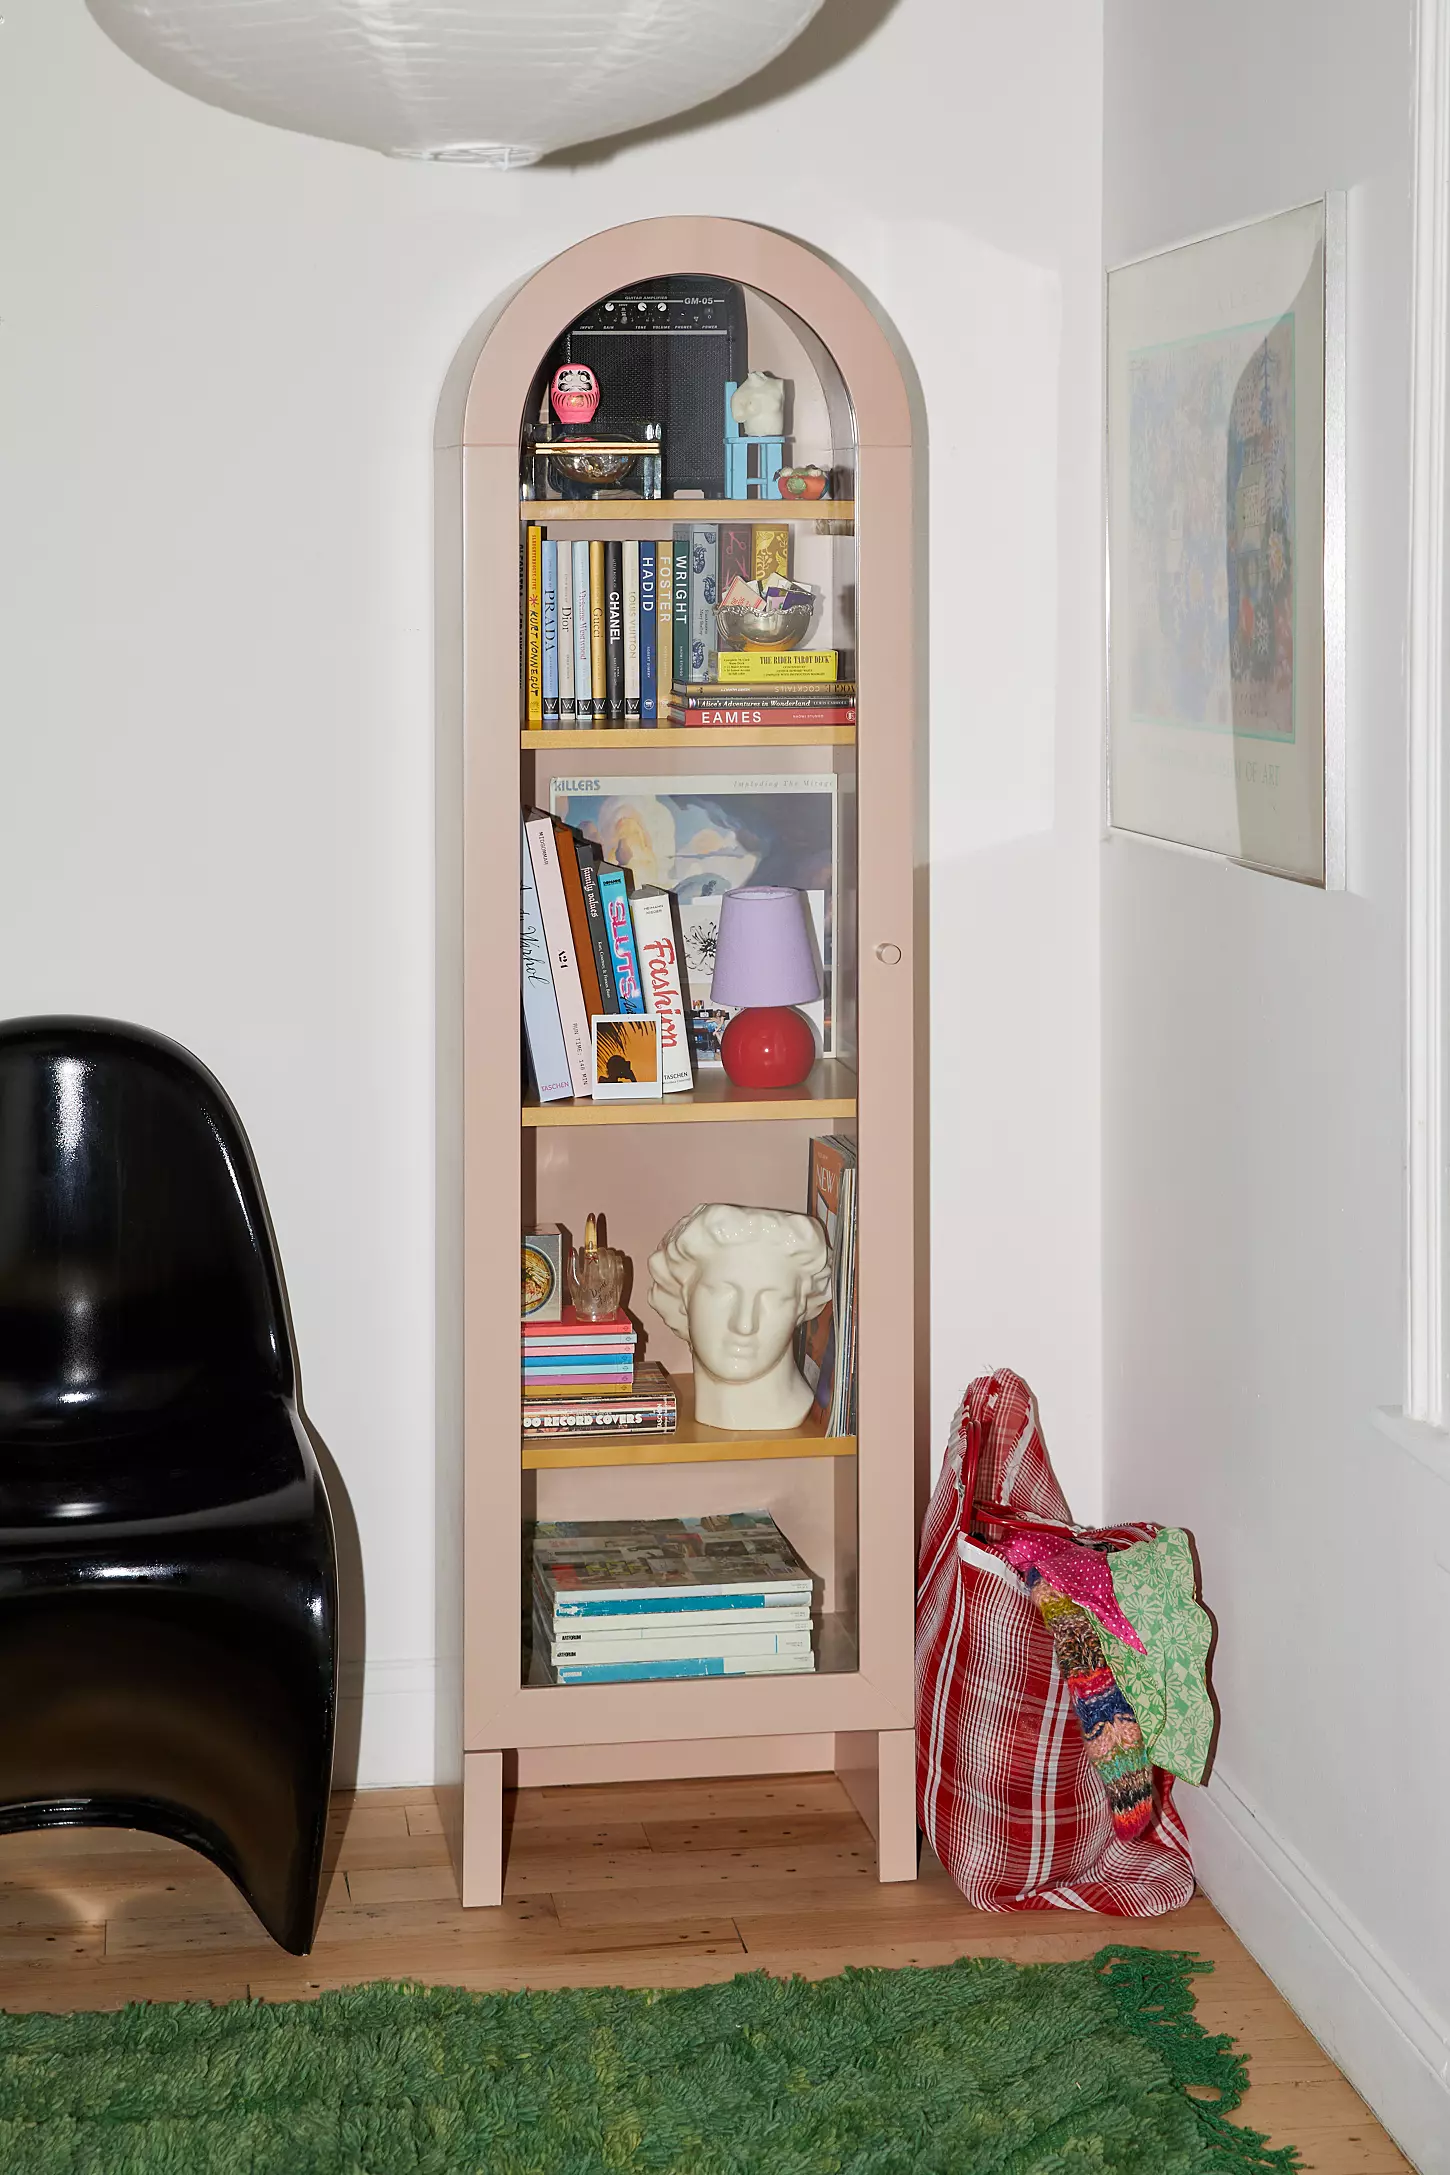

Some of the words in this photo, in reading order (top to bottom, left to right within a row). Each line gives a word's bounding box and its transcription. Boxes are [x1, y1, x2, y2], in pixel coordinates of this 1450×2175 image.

[684, 297, 713, 305] GM-05
[642, 557, 653, 611] HADID
[660, 556, 671, 622] FOSTER
[675, 556, 687, 624] WRIGHT
[579, 590, 587, 621] Vivienne
[609, 591, 620, 645] CHANEL
[628, 591, 636, 617] LOUIS
[529, 609, 539, 638] KURT
[544, 590, 556, 651] PRADA
[562, 607, 572, 632] Dior
[593, 607, 603, 638] Gucci
[628, 619, 636, 659] VUITTON
[529, 640, 539, 697] VONNEGUT
[760, 656, 772, 665] THE
[773, 656, 792, 664] RIDER
[794, 656, 814, 664] TAROT
[701, 699, 723, 707] Alice's
[724, 699, 760, 707] Adventures
[770, 699, 811, 707] Wonderland
[701, 711, 762, 724] EAMES
[554, 779, 601, 791] KILLERS
[732, 780, 779, 789] Imploding
[580, 866, 594, 892] family
[587, 892, 599, 918] values
[520, 926, 550, 988] Warhol
[608, 900, 637, 999] SLUTS
[643, 937, 681, 1048] Fashion
[541, 1081, 569, 1092] TASCHEN
[664, 1071, 688, 1080] TASCHEN
[816, 1164, 836, 1194] NEW
[544, 1415, 593, 1427] RECORD
[595, 1414, 643, 1426] COVERS
